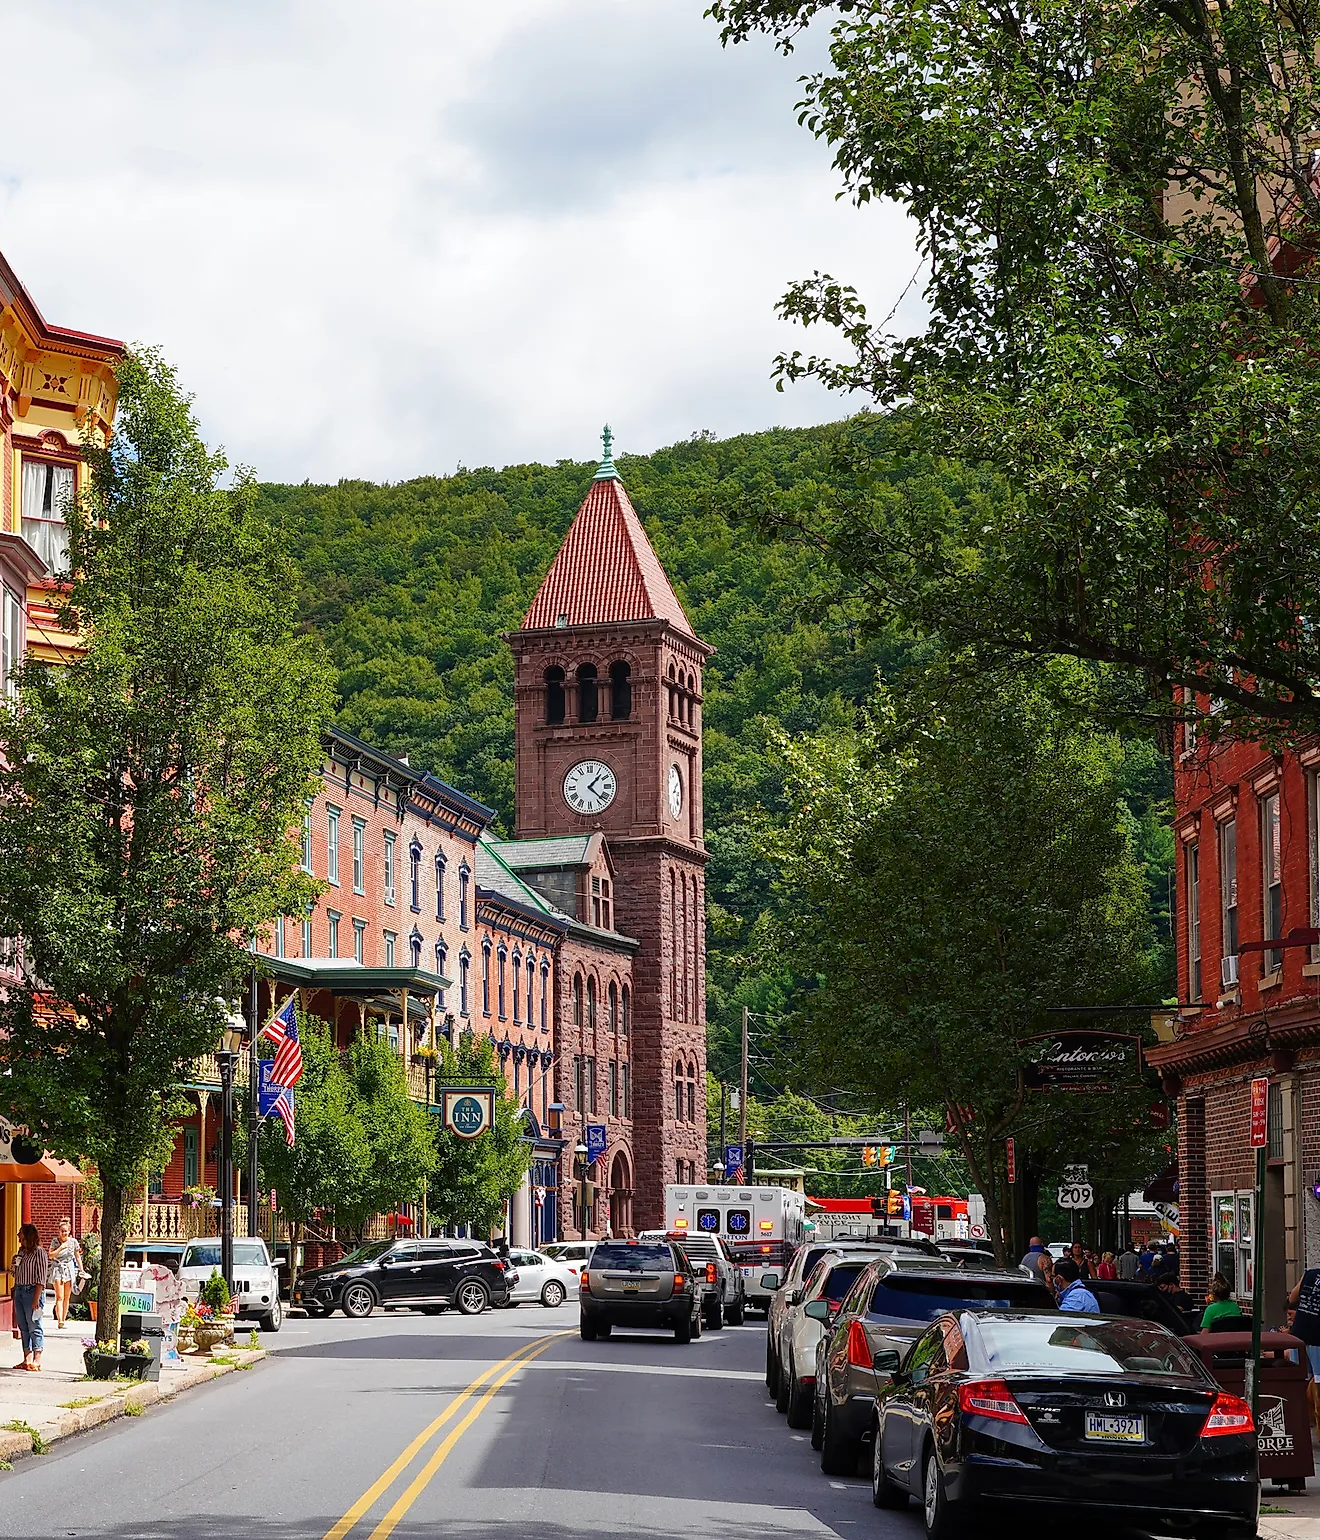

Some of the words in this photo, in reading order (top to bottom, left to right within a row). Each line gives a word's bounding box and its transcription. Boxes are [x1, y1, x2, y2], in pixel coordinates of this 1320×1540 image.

[455, 1112, 481, 1122] INN
[1060, 1188, 1090, 1203] 209
[138, 1299, 151, 1312] END
